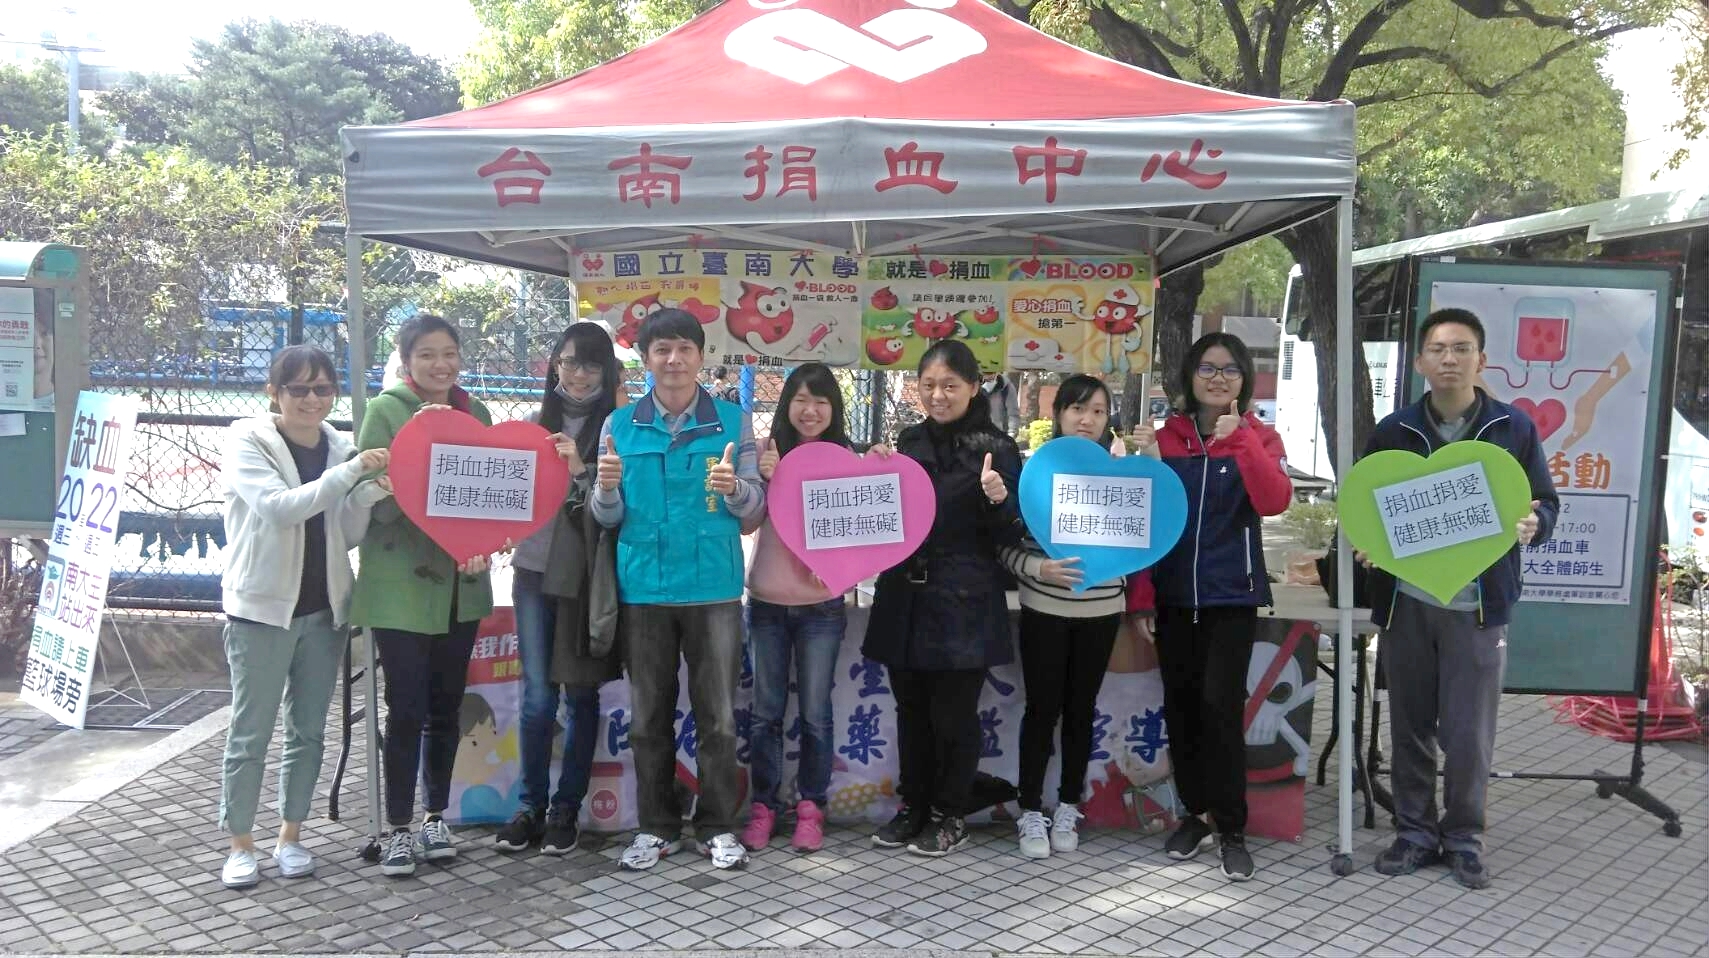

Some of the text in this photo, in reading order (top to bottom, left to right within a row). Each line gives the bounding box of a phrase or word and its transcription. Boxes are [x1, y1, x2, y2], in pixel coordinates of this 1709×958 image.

[478, 136, 1228, 209] 台南捐血中心
[614, 251, 859, 279] 國立臺南大學
[1046, 263, 1134, 280] BLOOD
[809, 283, 857, 294] BLOOD
[1012, 299, 1072, 313] 愛心捐血
[1038, 318, 1077, 329] 搶第一
[436, 453, 530, 480] 捐血捐愛
[86, 482, 118, 534] 22
[434, 484, 528, 510] 健康無礙
[808, 483, 895, 510] 捐血捐愛
[1058, 483, 1146, 508] 捐血捐愛
[1384, 473, 1483, 517] 捐血捐愛
[811, 512, 897, 539] 健康無礙
[1058, 512, 1145, 537] 健康無礙
[1393, 503, 1493, 547] 健康無礙
[1523, 559, 1604, 577] 大全體師生
